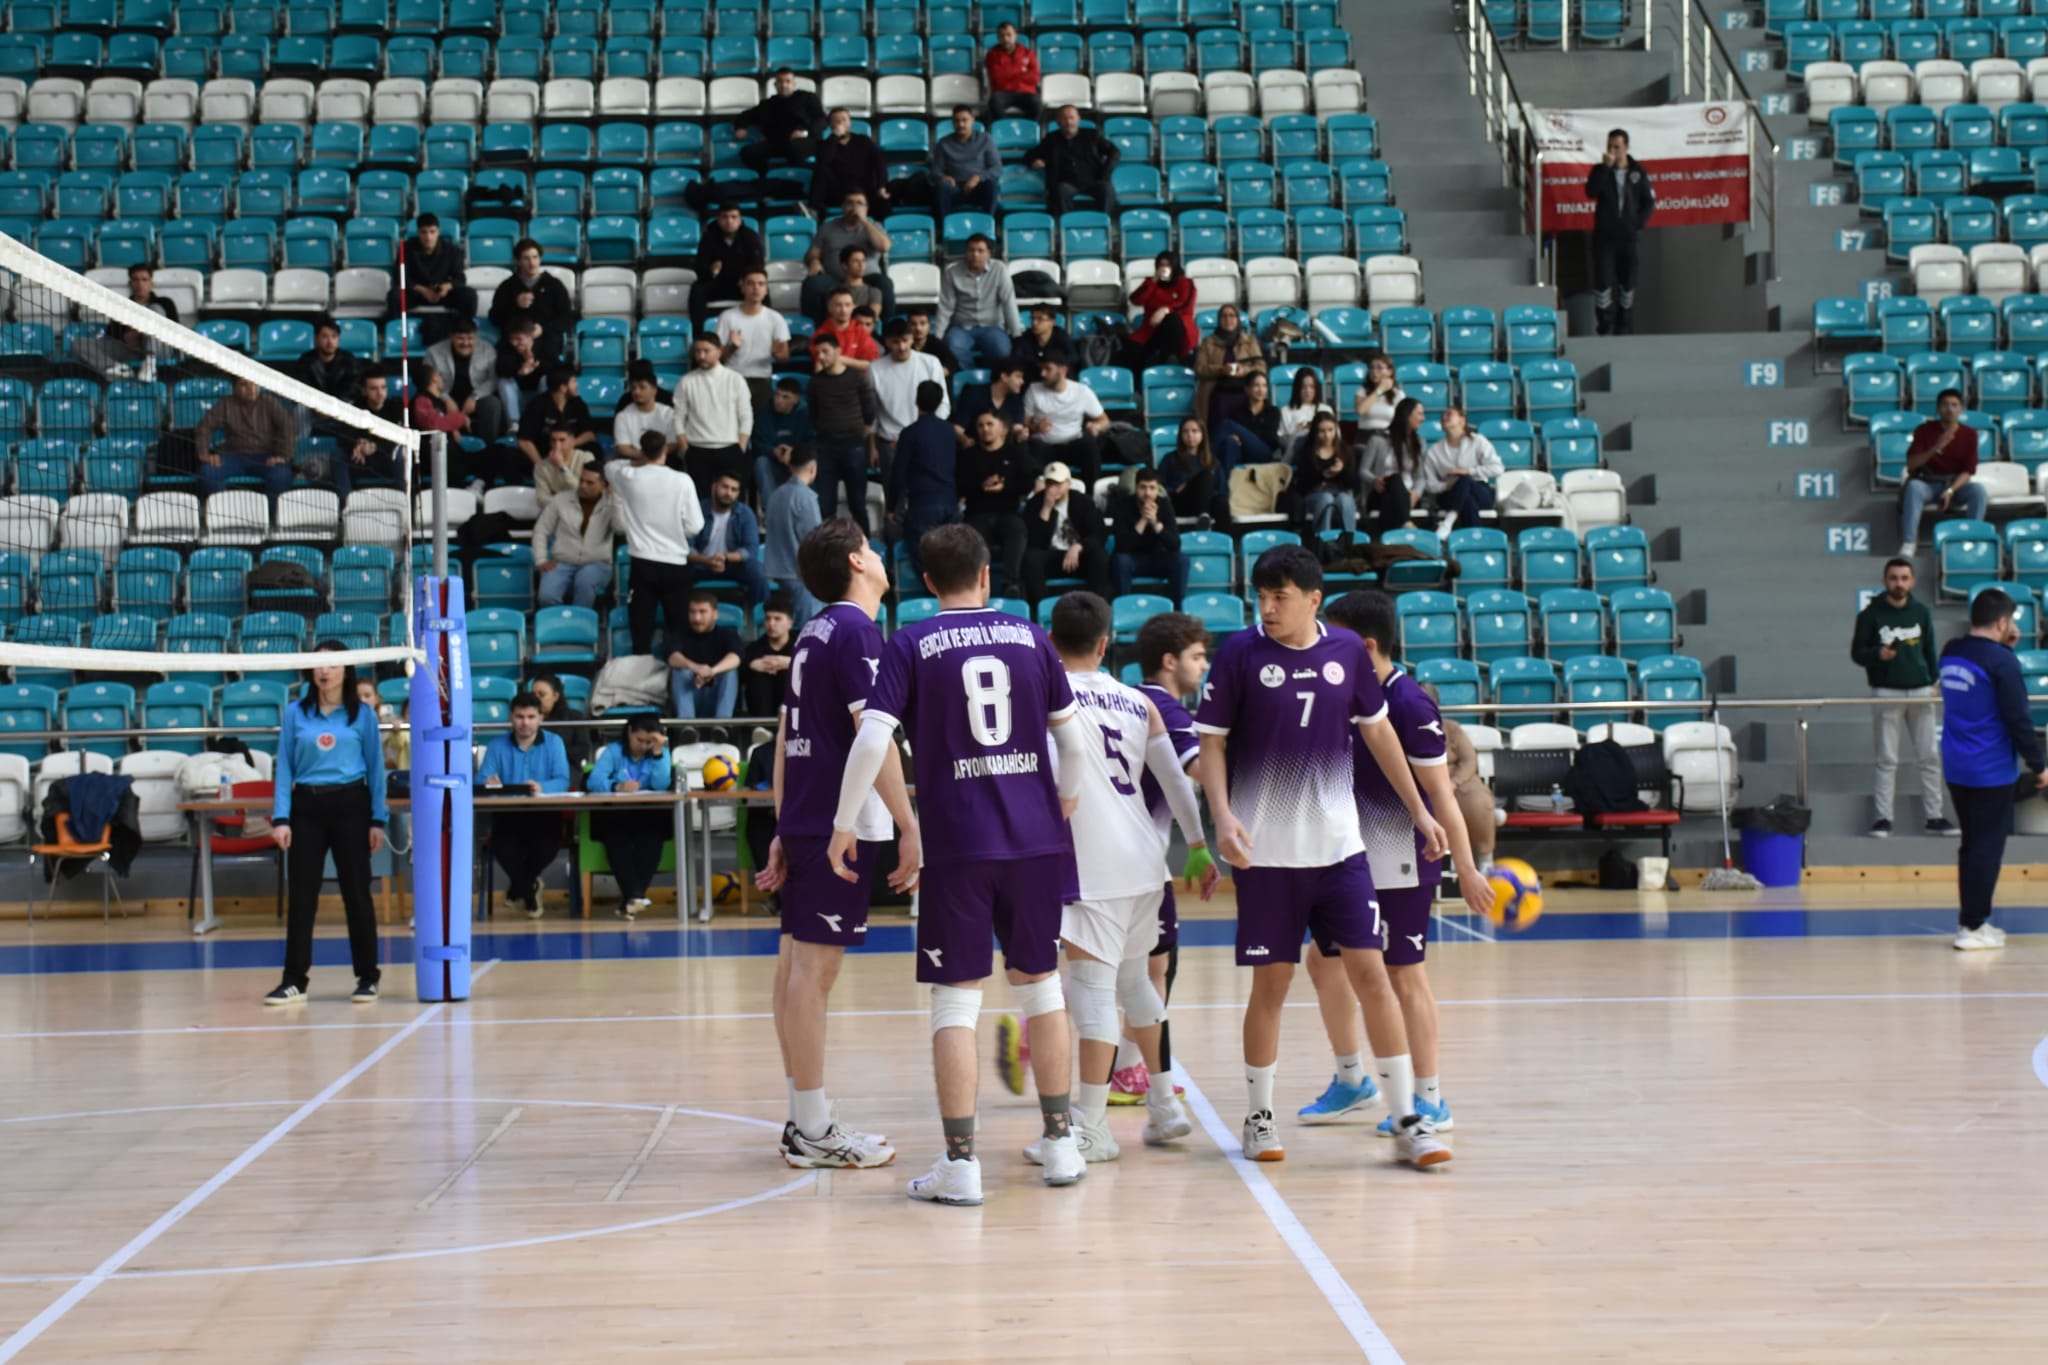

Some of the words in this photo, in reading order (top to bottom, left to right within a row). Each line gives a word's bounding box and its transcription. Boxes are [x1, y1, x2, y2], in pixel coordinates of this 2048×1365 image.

[1726, 12, 1749, 29] F2
[1746, 52, 1769, 72] F3
[1767, 95, 1790, 115] F4
[1792, 139, 1816, 160] F5
[1816, 186, 1841, 206] F6
[1556, 201, 1597, 214] TINAZT
[1840, 230, 1865, 251] F7
[1867, 282, 1893, 303] F8
[1750, 363, 1778, 385] F9
[1770, 422, 1809, 444] F10
[1798, 474, 1835, 496] F11
[1828, 528, 1868, 550] F12
[949, 628, 962, 649] VE
[960, 626, 984, 648] SPOR
[961, 655, 1012, 747] 8
[1296, 691, 1316, 727] 7
[953, 748, 1038, 780] AFYONKARAHİSAR
[1099, 723, 1136, 796] 5
[1368, 900, 1381, 936] 7
